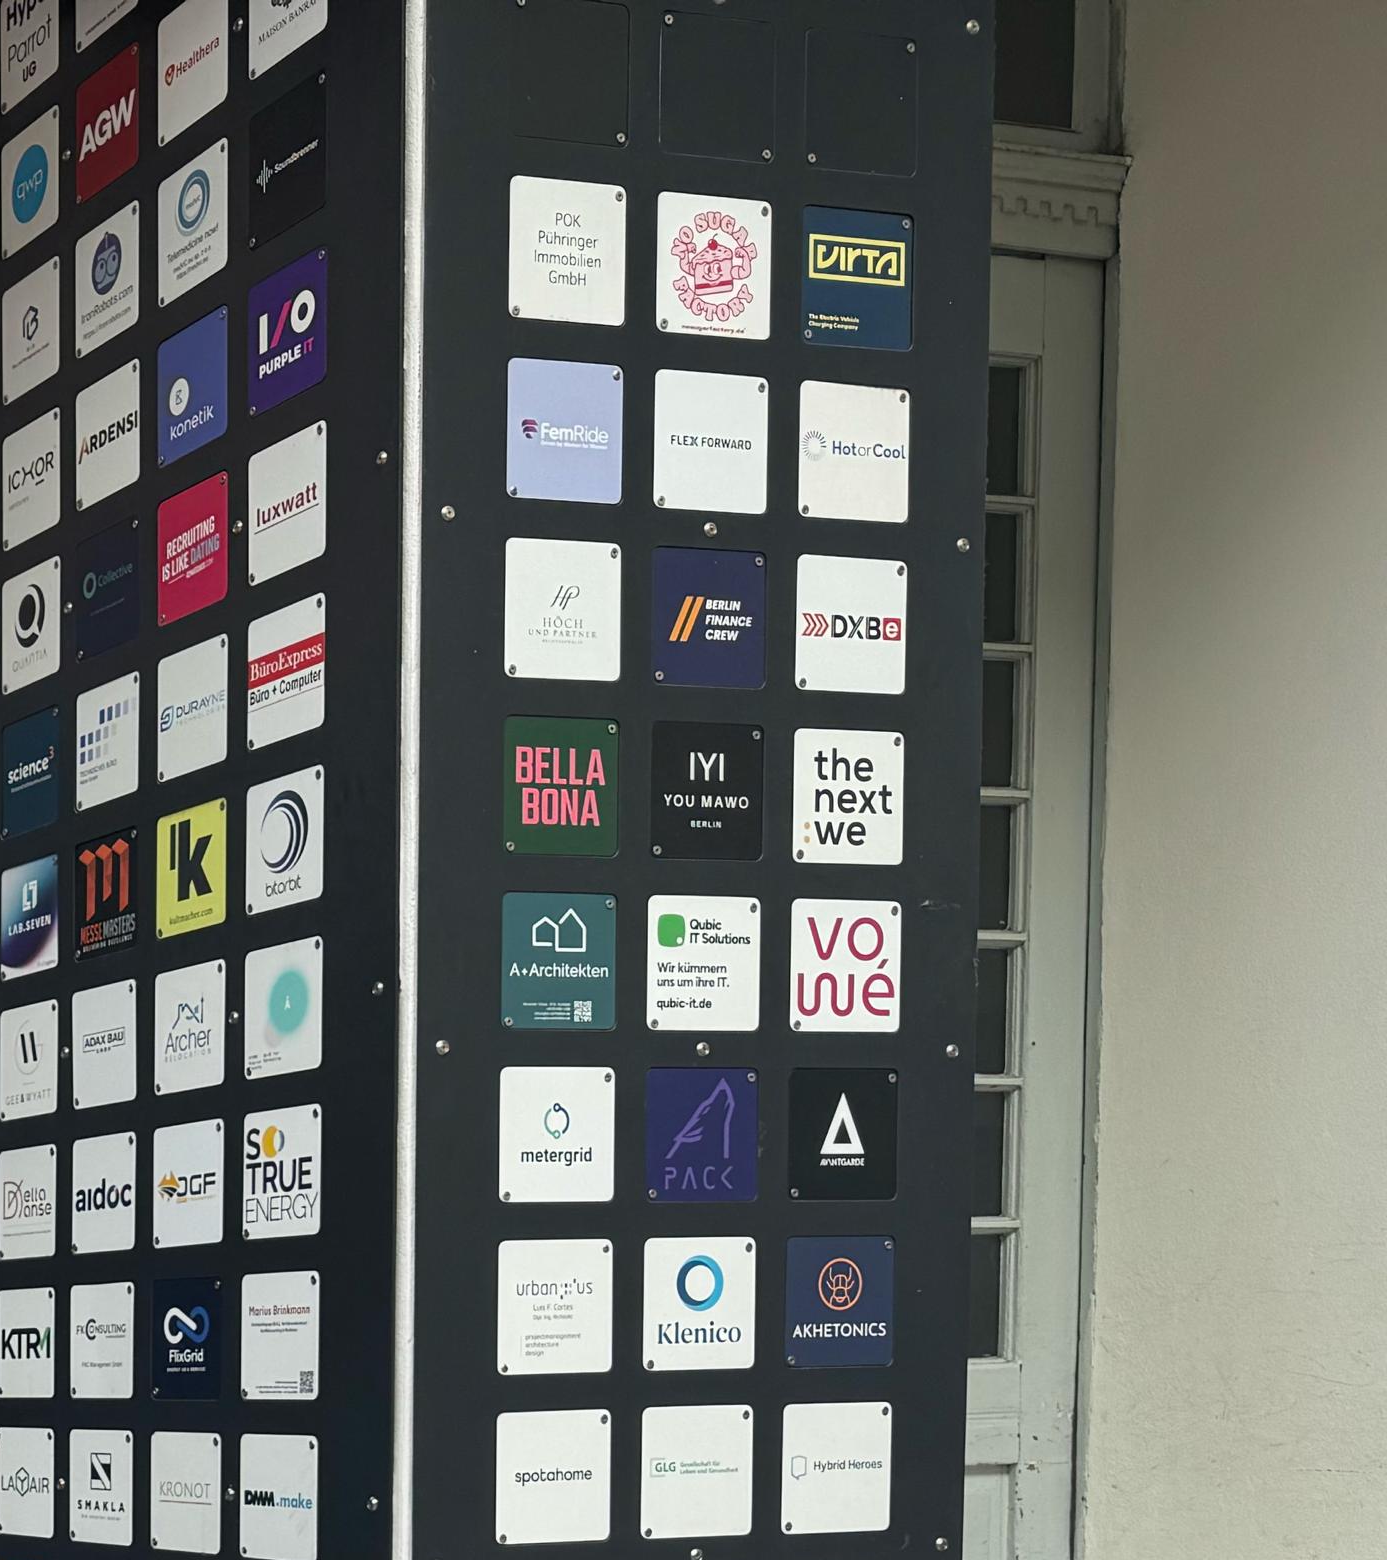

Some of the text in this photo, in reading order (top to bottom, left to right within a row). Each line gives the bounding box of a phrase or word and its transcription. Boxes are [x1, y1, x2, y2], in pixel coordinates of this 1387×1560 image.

[7, 0, 43, 31] Hyp
[8, 13, 51, 72] Parrot
[175, 35, 221, 78] Healthera
[23, 61, 36, 82] UG
[78, 88, 138, 163] AGW
[554, 212, 582, 229] POK
[537, 228, 599, 251] Pühringer
[671, 211, 757, 260] NO SUGAR
[533, 248, 602, 270] Immobilien
[547, 270, 588, 287] GmbH
[673, 276, 753, 322] FACTORY
[257, 288, 317, 356] I/O
[808, 321, 832, 329] Charging
[257, 336, 315, 381] PURPLE IT
[168, 404, 215, 442] konetik
[541, 422, 608, 443] FemRide
[669, 433, 753, 452] FLEX FORWARD
[831, 440, 907, 461] HotorCool
[255, 481, 319, 529] luxwatt
[165, 514, 216, 560] RECRUITING
[161, 563, 171, 583] IS
[170, 552, 190, 577] LIKE
[189, 532, 221, 564] DATING
[96, 562, 134, 588] Collective
[704, 598, 742, 613] BERLIN
[704, 613, 754, 629] FINANCE
[553, 629, 597, 638] PARTNER
[704, 627, 739, 642] CREW
[249, 640, 324, 682] BüroExpress
[249, 687, 271, 707] Büro
[278, 667, 323, 696] Computer
[174, 689, 226, 719] DURAYNE
[514, 745, 607, 788] BELLA
[812, 747, 875, 783] the
[520, 787, 601, 828] BONA
[663, 793, 750, 811] YOU MAWO
[813, 784, 894, 815] next
[689, 819, 723, 829] BERLIN
[813, 819, 868, 847] we
[7, 913, 53, 938] LAB.SEVEN
[168, 906, 215, 927] kultmacher.com
[689, 918, 723, 933] Qubic
[79, 912, 137, 946] MESSEMASTERS
[689, 932, 752, 947] IT Solutions
[656, 961, 728, 975] Wir kümmern
[656, 976, 730, 989] uns um ihre IT.
[655, 997, 713, 1011] qubic-it.de
[83, 1030, 125, 1049] ADAX BAU
[164, 1027, 212, 1056] Archer
[520, 1146, 593, 1167] metergrid
[245, 1155, 314, 1196] TRUE
[663, 1165, 735, 1191] PACK
[75, 1177, 133, 1213] aidoc
[244, 1190, 319, 1225] ENERGY
[247, 1302, 312, 1318] Marius Brinkmann
[656, 1320, 742, 1346] Klenico
[791, 1321, 888, 1340] AKHETONICS
[167, 1347, 205, 1364] FlixGrid
[655, 1462, 676, 1472] GLG
[812, 1456, 883, 1473] Hybrid Heroes
[514, 1466, 593, 1488] spotahome
[158, 1480, 212, 1501] KRONOT
[242, 1488, 314, 1511] DMM.make
